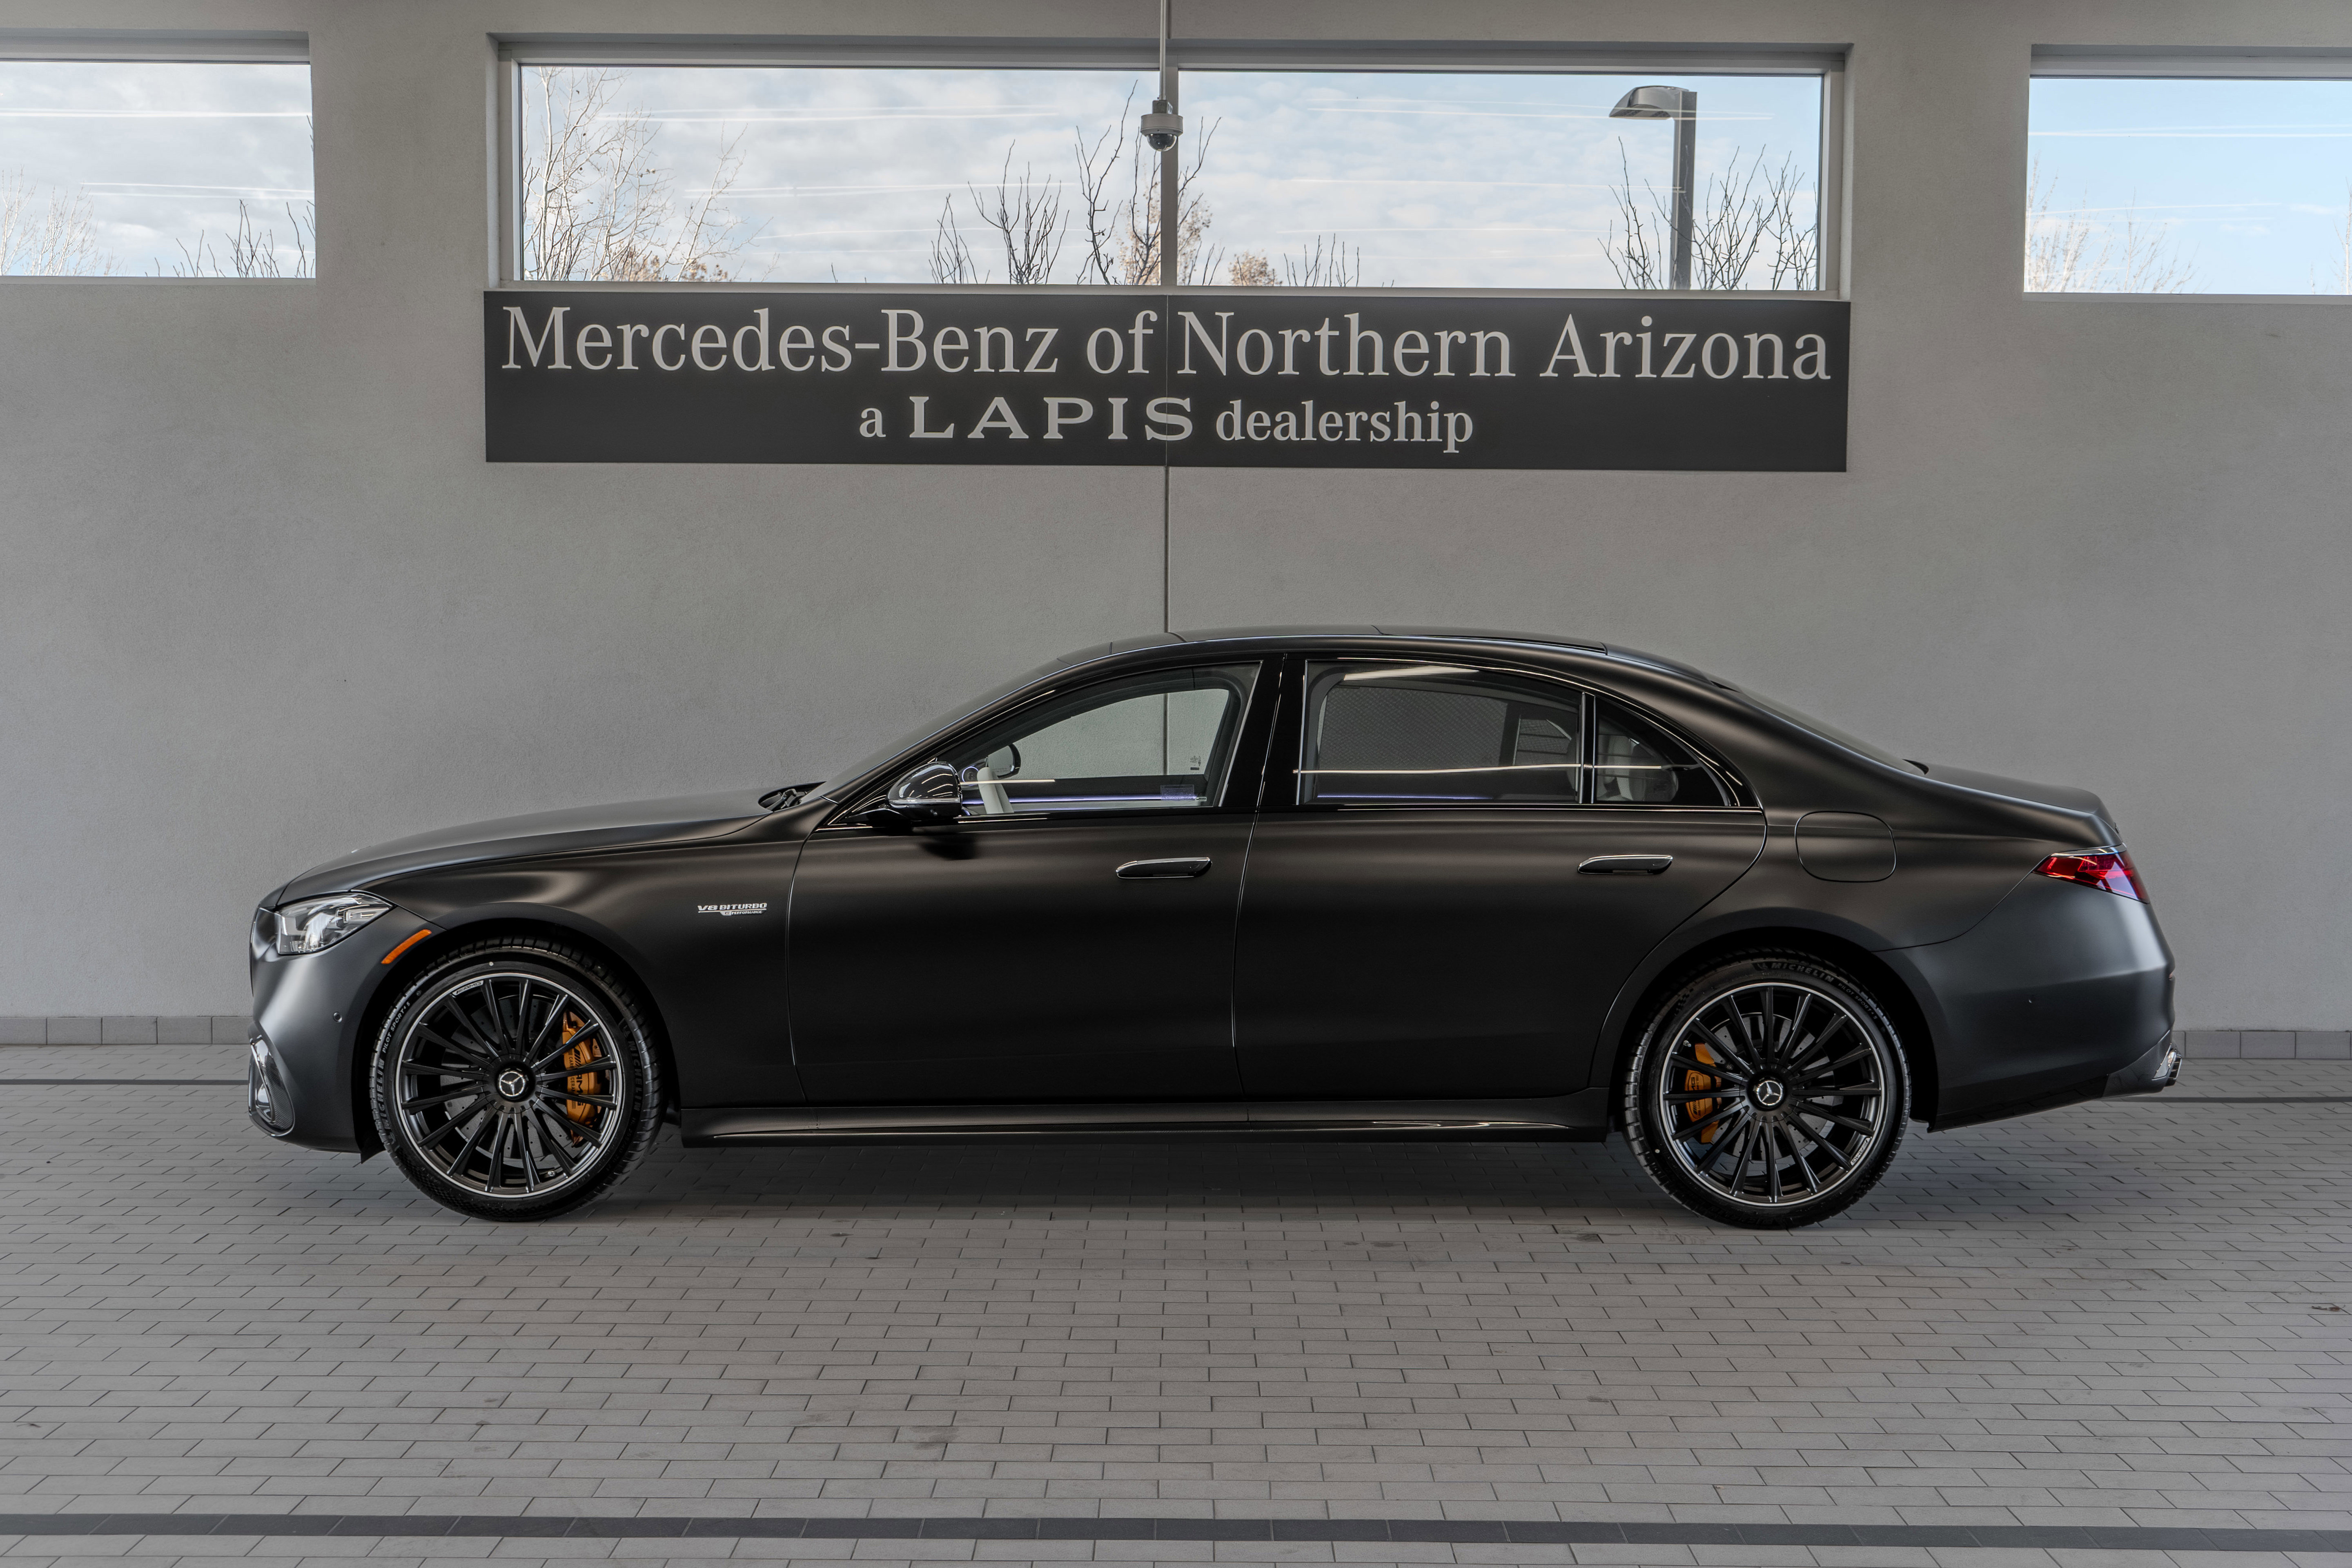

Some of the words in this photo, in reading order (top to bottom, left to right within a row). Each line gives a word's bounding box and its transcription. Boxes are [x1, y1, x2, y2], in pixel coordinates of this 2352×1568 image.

[502, 306, 1059, 373] Mercedes-Benz
[1087, 310, 1158, 374] of
[1177, 311, 1516, 377] Northern
[1539, 313, 1831, 380] Arizona
[859, 408, 886, 438] a
[909, 396, 1193, 441] LAPIS
[1216, 399, 1473, 453] dealership
[1771, 962, 1835, 982] MICHELIN
[1838, 983, 1854, 995] PILOT
[382, 1032, 392, 1054] PILOT
[376, 1058, 392, 1129] MICHELIN
[628, 1040, 643, 1111] MICHELIN
